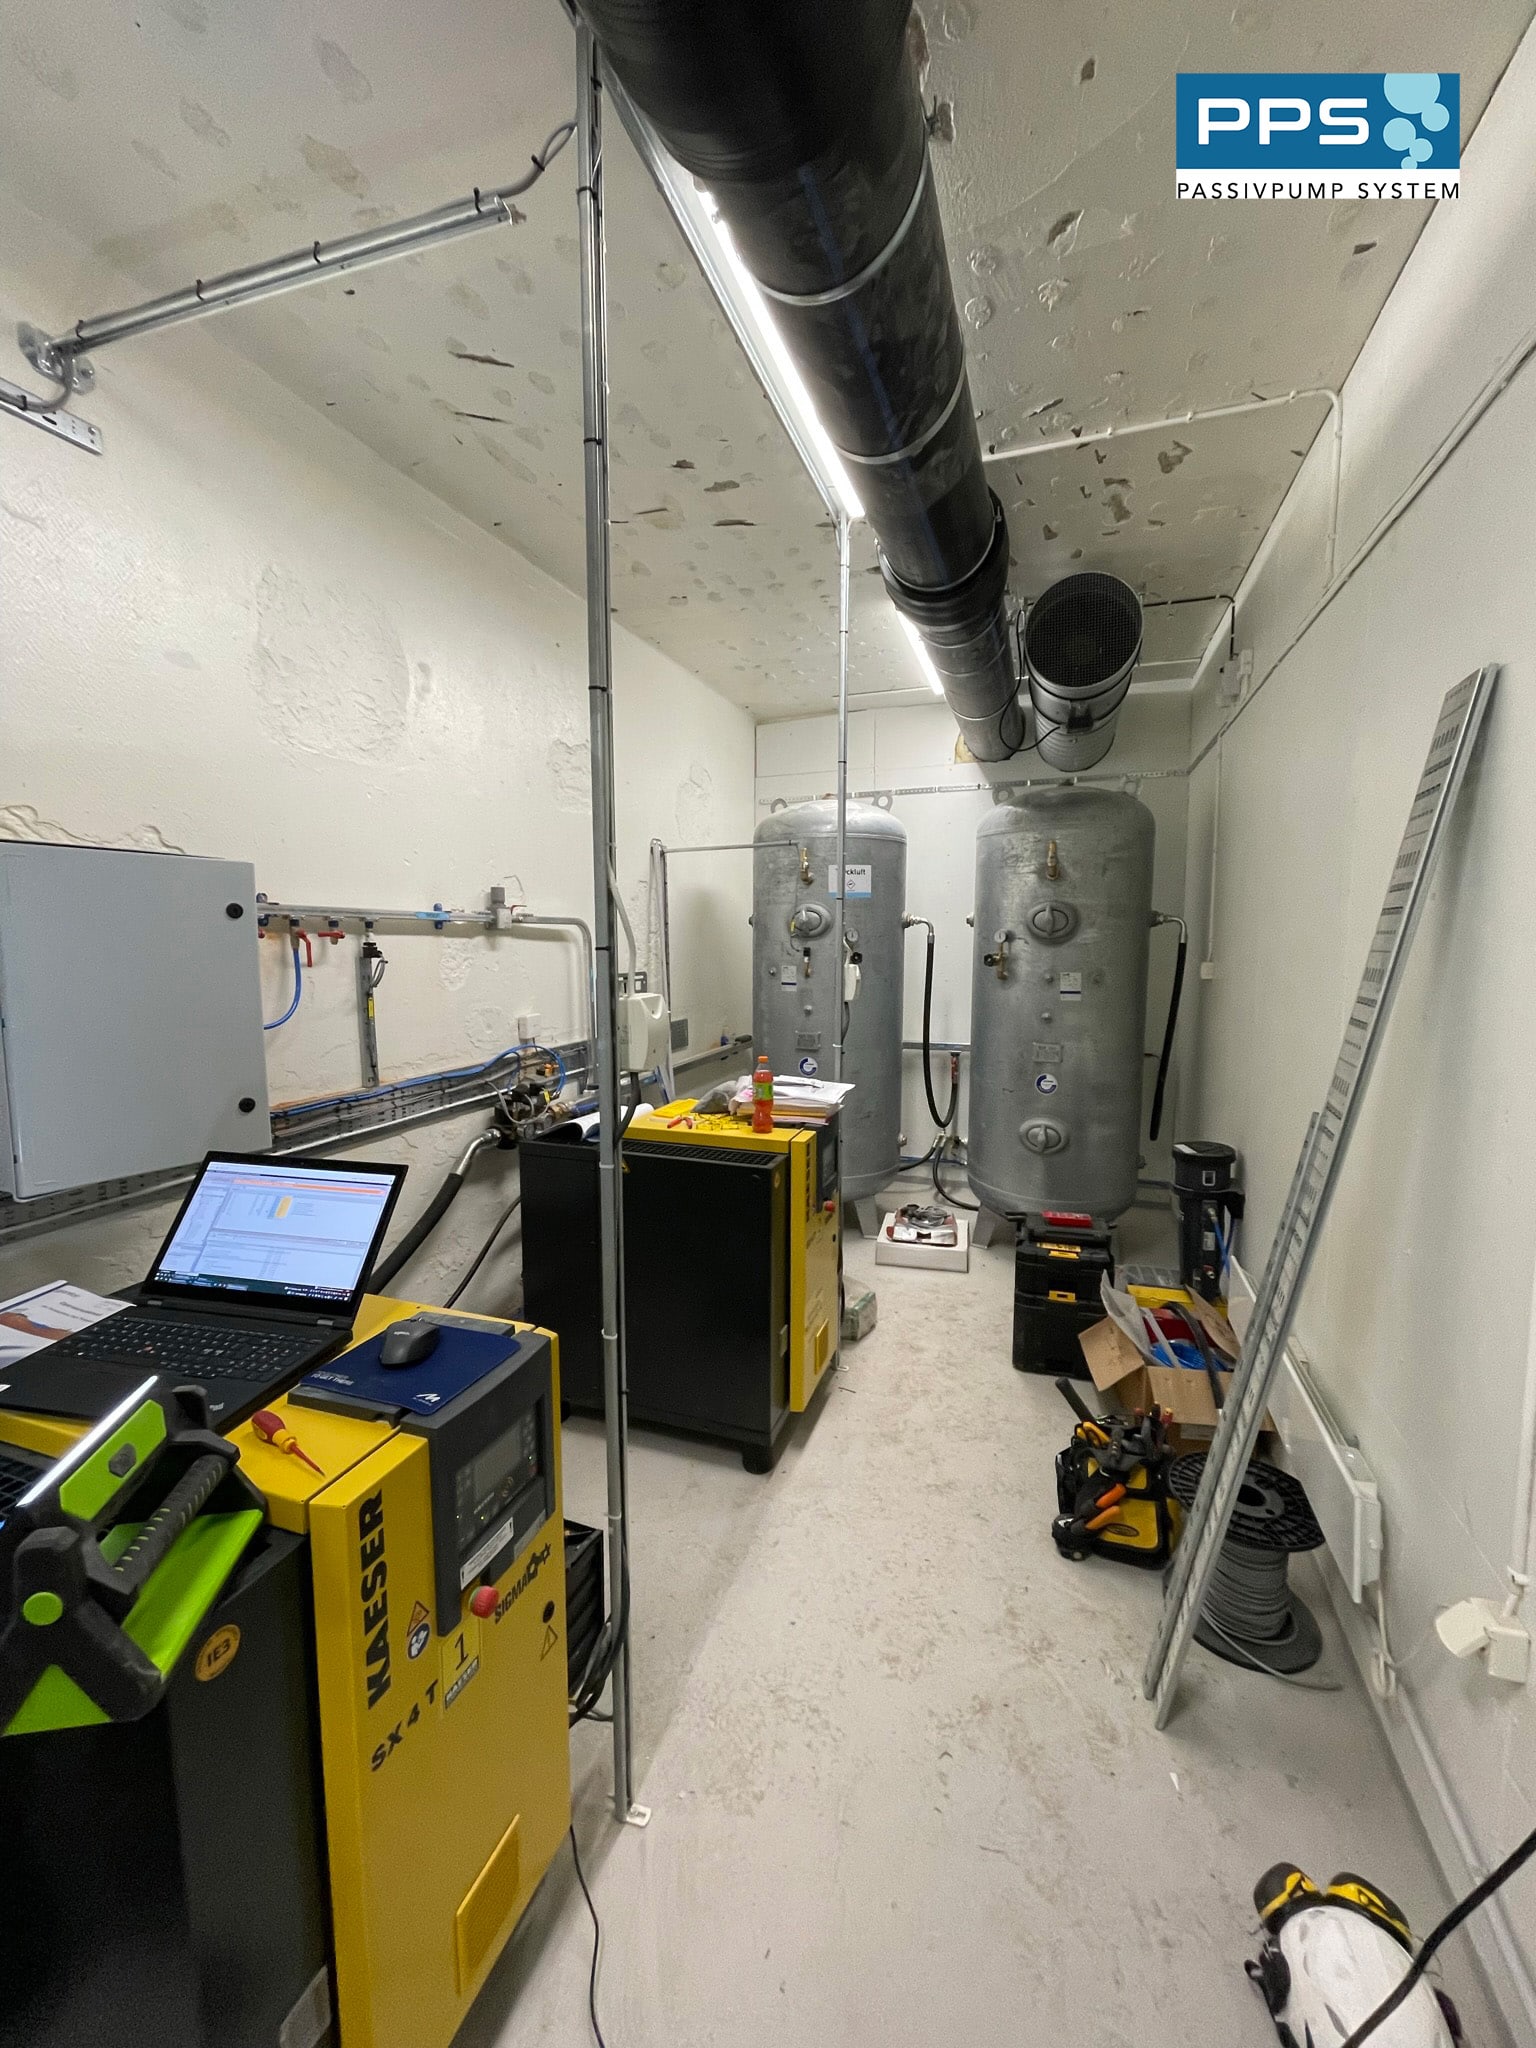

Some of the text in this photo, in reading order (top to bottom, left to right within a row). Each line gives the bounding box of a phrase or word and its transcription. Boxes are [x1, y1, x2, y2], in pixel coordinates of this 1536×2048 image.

[359, 1487, 391, 1711] KAESER
[495, 1572, 532, 1625] SIGMA
[207, 1638, 230, 1668] IE3
[454, 1632, 469, 1671] 1
[371, 1678, 439, 1772] SX 4 T
